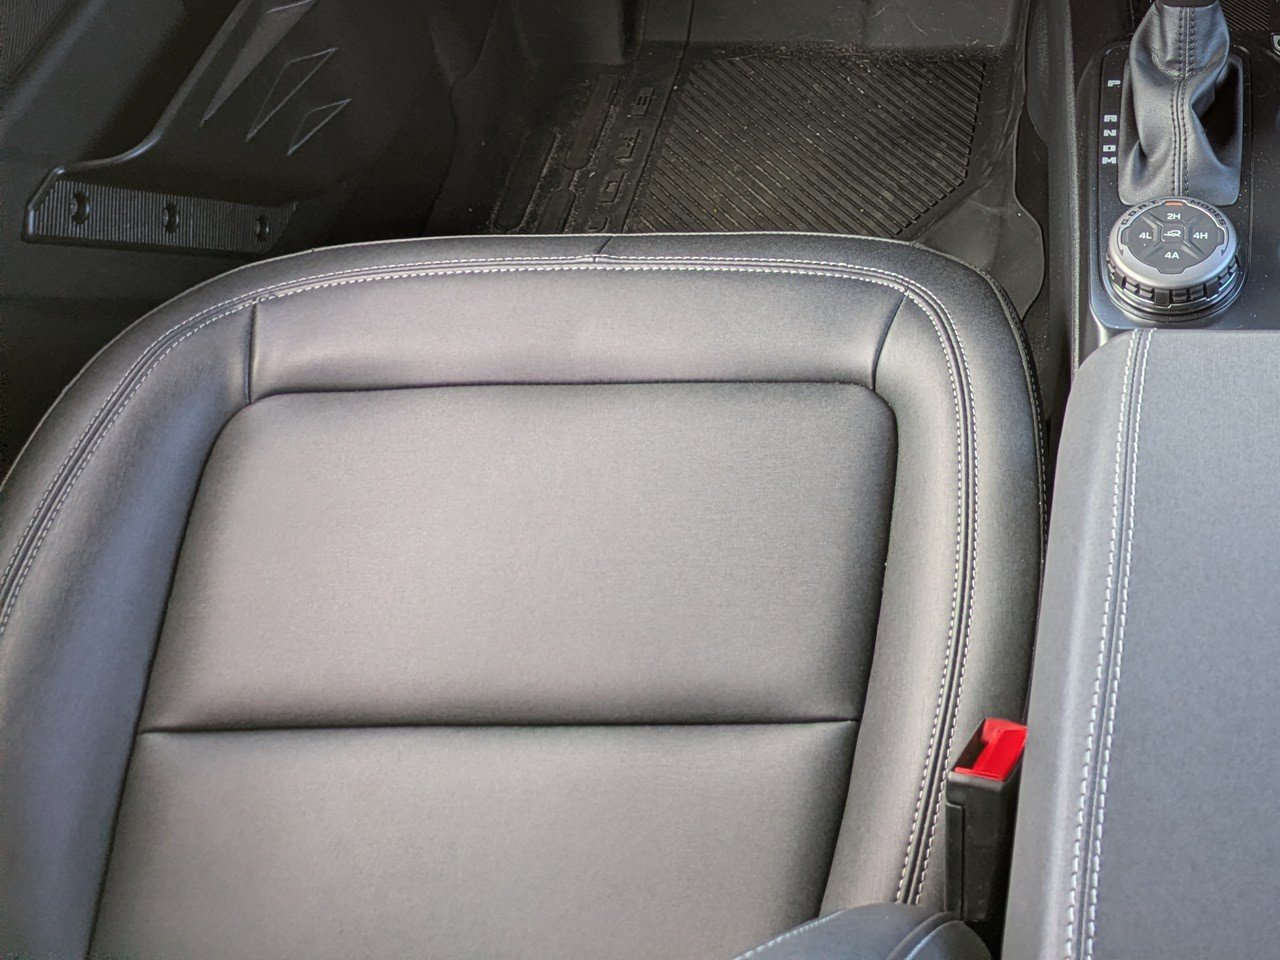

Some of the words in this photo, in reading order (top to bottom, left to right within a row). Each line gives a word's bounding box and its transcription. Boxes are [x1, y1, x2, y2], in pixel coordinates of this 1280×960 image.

[1107, 79, 1121, 87] P
[1103, 129, 1117, 137] N
[1101, 156, 1117, 165] M
[1190, 199, 1228, 226] MODES
[1192, 232, 1208, 240] 4H
